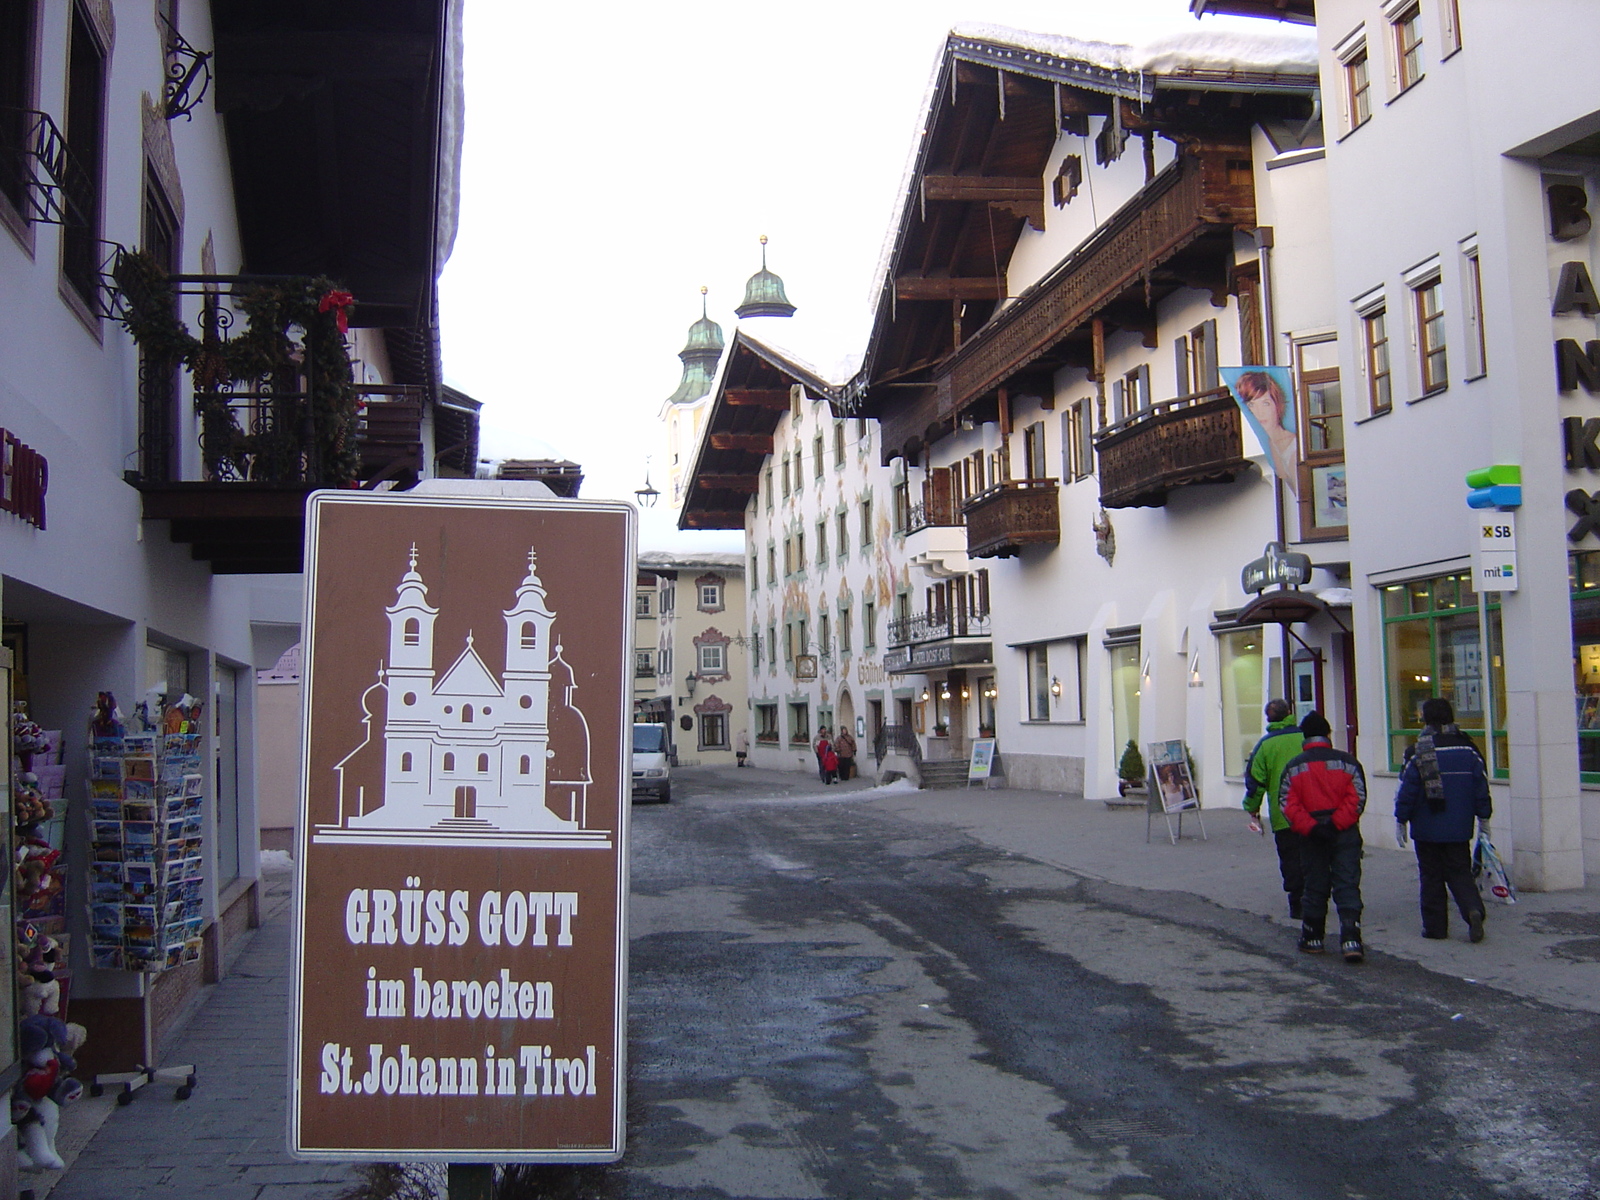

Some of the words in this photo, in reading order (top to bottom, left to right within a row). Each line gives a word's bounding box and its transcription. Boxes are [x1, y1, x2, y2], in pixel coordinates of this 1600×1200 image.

[1548, 183, 1600, 469] BANK
[1494, 525, 1512, 539] SB
[1483, 566, 1502, 578] mit
[345, 875, 470, 946] GRÜSS
[478, 890, 578, 946] GOTT
[366, 966, 406, 1017] im
[413, 967, 554, 1019] barocken
[484, 1044, 516, 1095] in
[520, 1045, 597, 1095] Tirol
